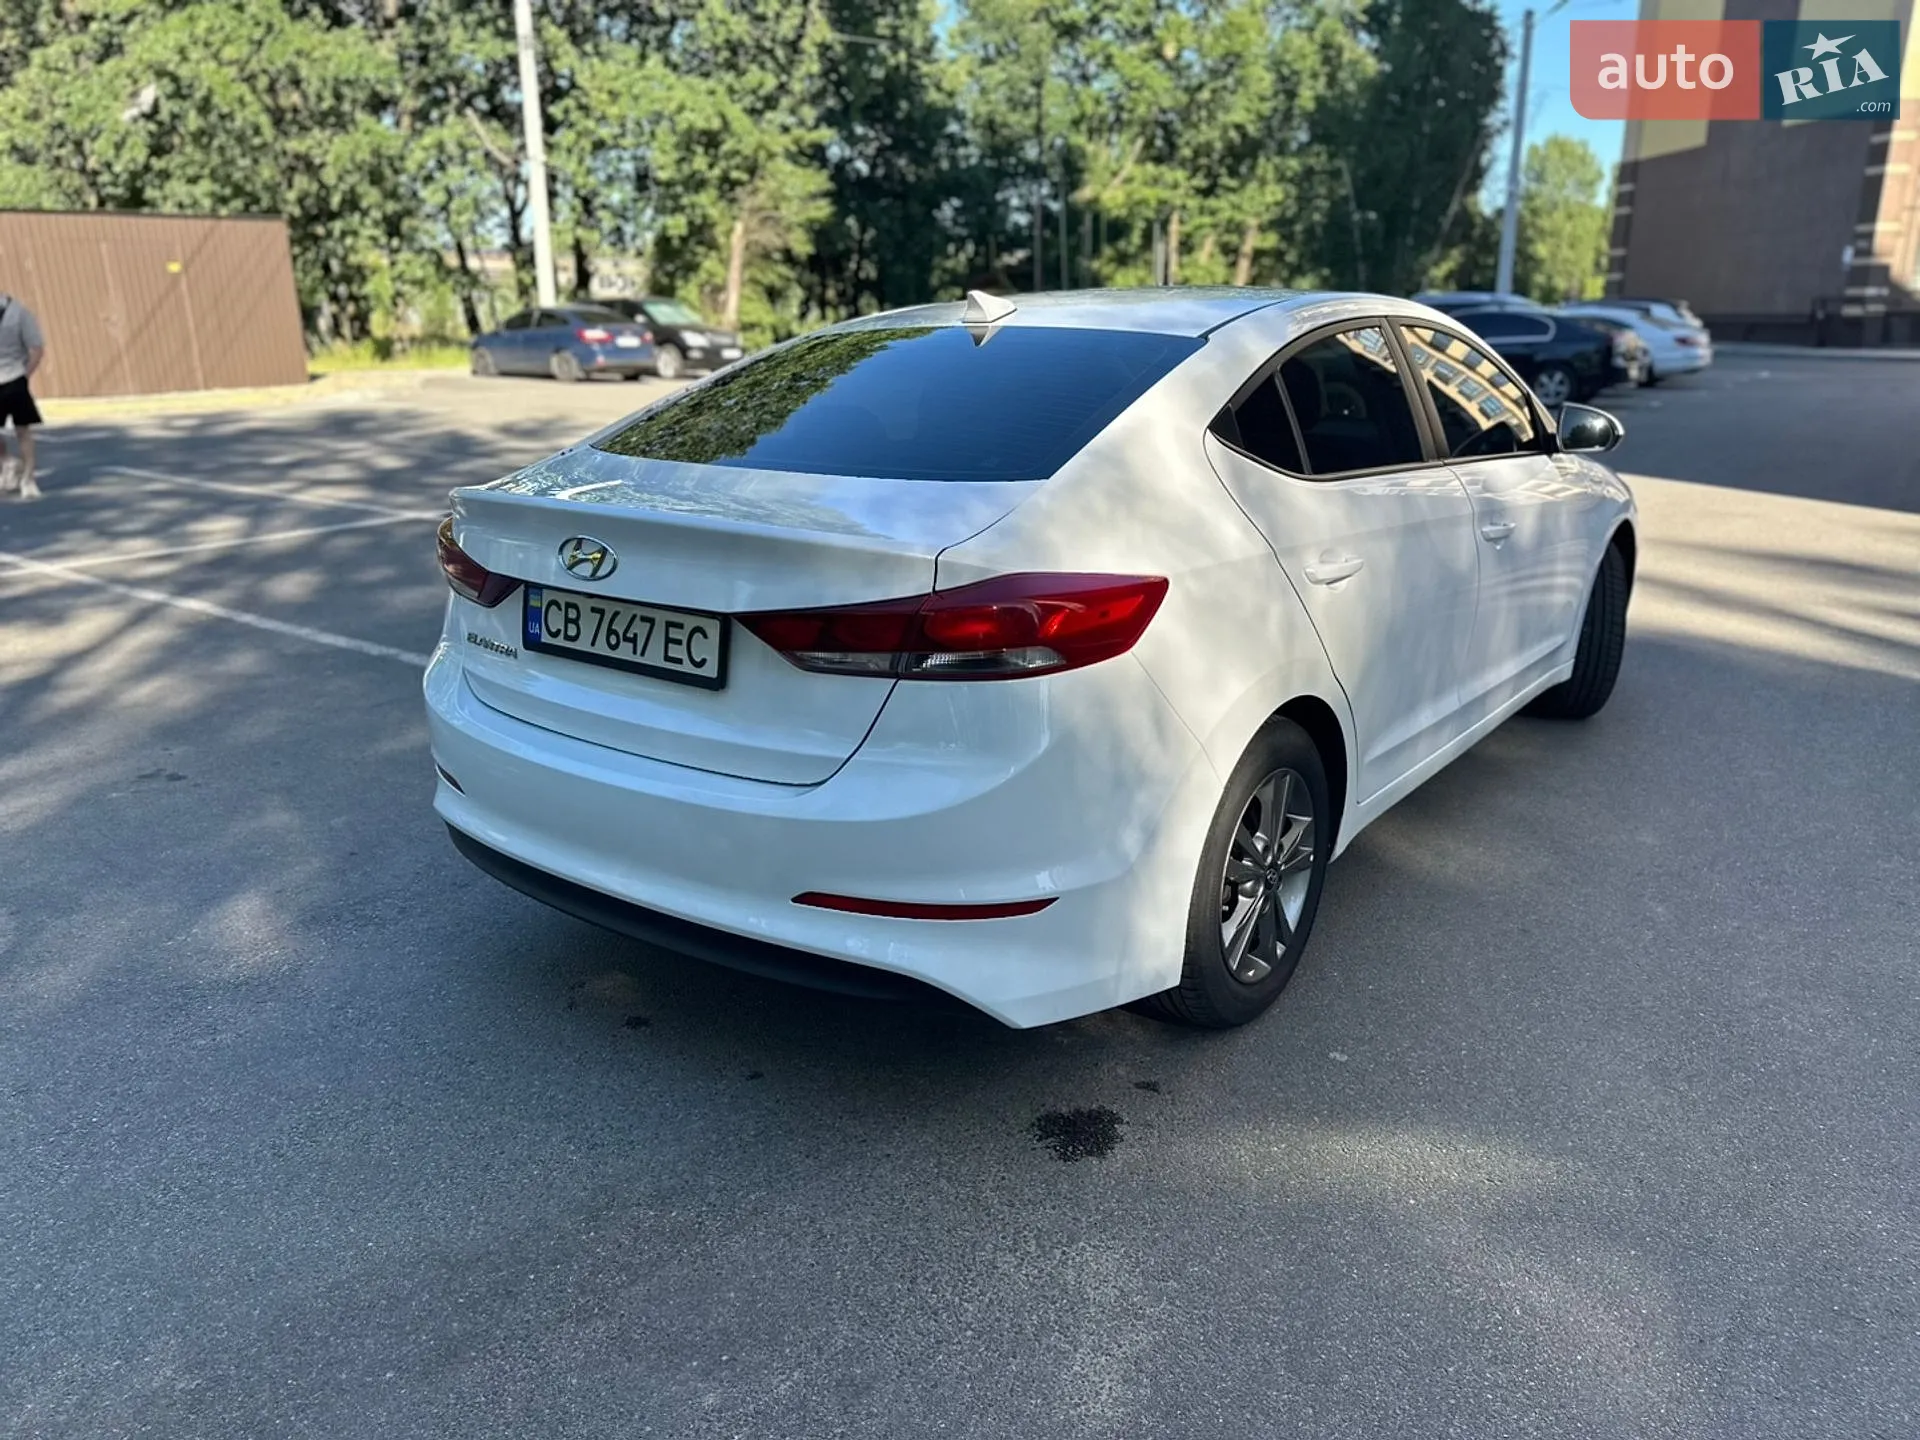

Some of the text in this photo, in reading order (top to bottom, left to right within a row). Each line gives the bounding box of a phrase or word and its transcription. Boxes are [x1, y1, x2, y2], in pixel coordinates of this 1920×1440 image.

[528, 621, 540, 635] UA
[544, 599, 709, 668] CB 7647 EC
